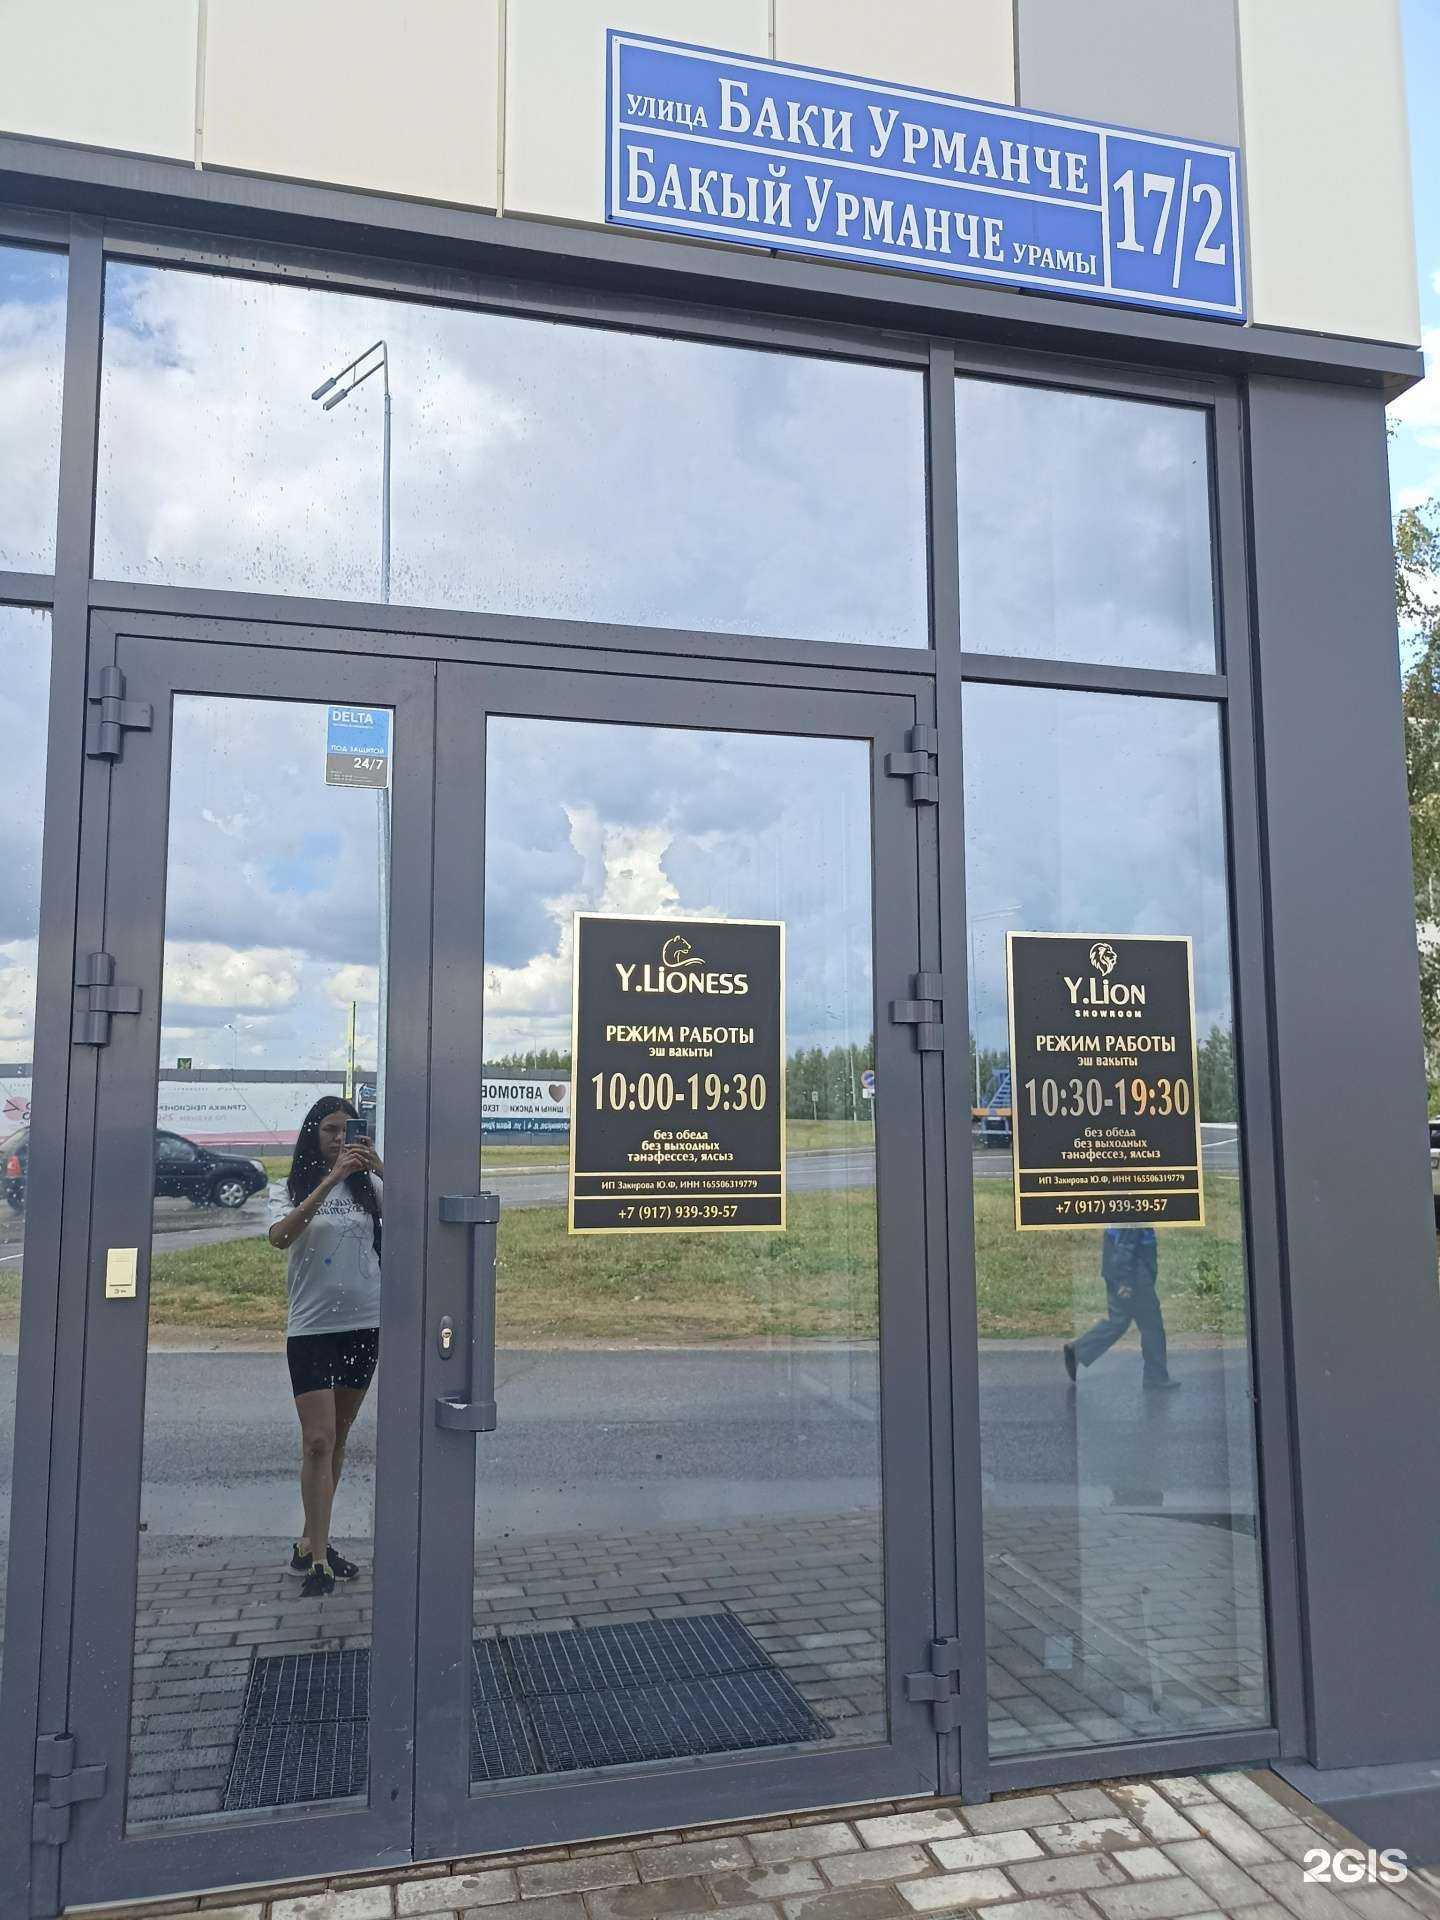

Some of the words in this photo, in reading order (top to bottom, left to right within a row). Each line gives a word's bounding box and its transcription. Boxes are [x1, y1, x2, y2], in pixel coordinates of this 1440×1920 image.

[1113, 158, 1227, 289] 17/2
[333, 711, 373, 724] DELTA
[353, 758, 384, 770] 24/7
[1075, 1009, 1142, 1018] SHOWROOM
[606, 1025, 673, 1042] РЕЖИМ
[680, 1027, 754, 1044] РАБОТЫ
[1036, 1035, 1100, 1051] РЕЖИМ
[1105, 1036, 1176, 1052] РАБОТЫ
[649, 1048, 666, 1057] эш
[669, 1047, 713, 1058] вакыты
[1078, 1056, 1094, 1066] эш
[1096, 1056, 1137, 1066] вакыты
[591, 1072, 767, 1111] 10:00-19:30
[1025, 1078, 1189, 1116] 10:30-19:30
[654, 1130, 673, 1140] без
[676, 1130, 708, 1141] обеда
[1085, 1127, 1103, 1137] без
[1106, 1127, 1136, 1138] обеда
[642, 1140, 661, 1151] без
[664, 1141, 720, 1151] выходных
[1074, 1138, 1093, 1148] без
[1095, 1139, 1147, 1149] выходных
[701, 1152, 734, 1162] ялсыз
[1130, 1149, 1160, 1159] ялсыз
[1039, 1176, 1052, 1184] ИП
[1054, 1175, 1088, 1185] Закирова
[1112, 1175, 1131, 1183] ИНН
[1133, 1174, 1184, 1182] 165506319779
[601, 1181, 616, 1189] ИП
[618, 1181, 654, 1191] Закирова
[681, 1181, 701, 1189] ИНН
[1056, 1203, 1071, 1214] +7
[1075, 1201, 1105, 1215] (917)
[1110, 1199, 1168, 1212] 939-39-57
[618, 1208, 635, 1219] +7
[638, 1207, 672, 1221] (917)
[675, 1205, 738, 1218] 939-39-57
